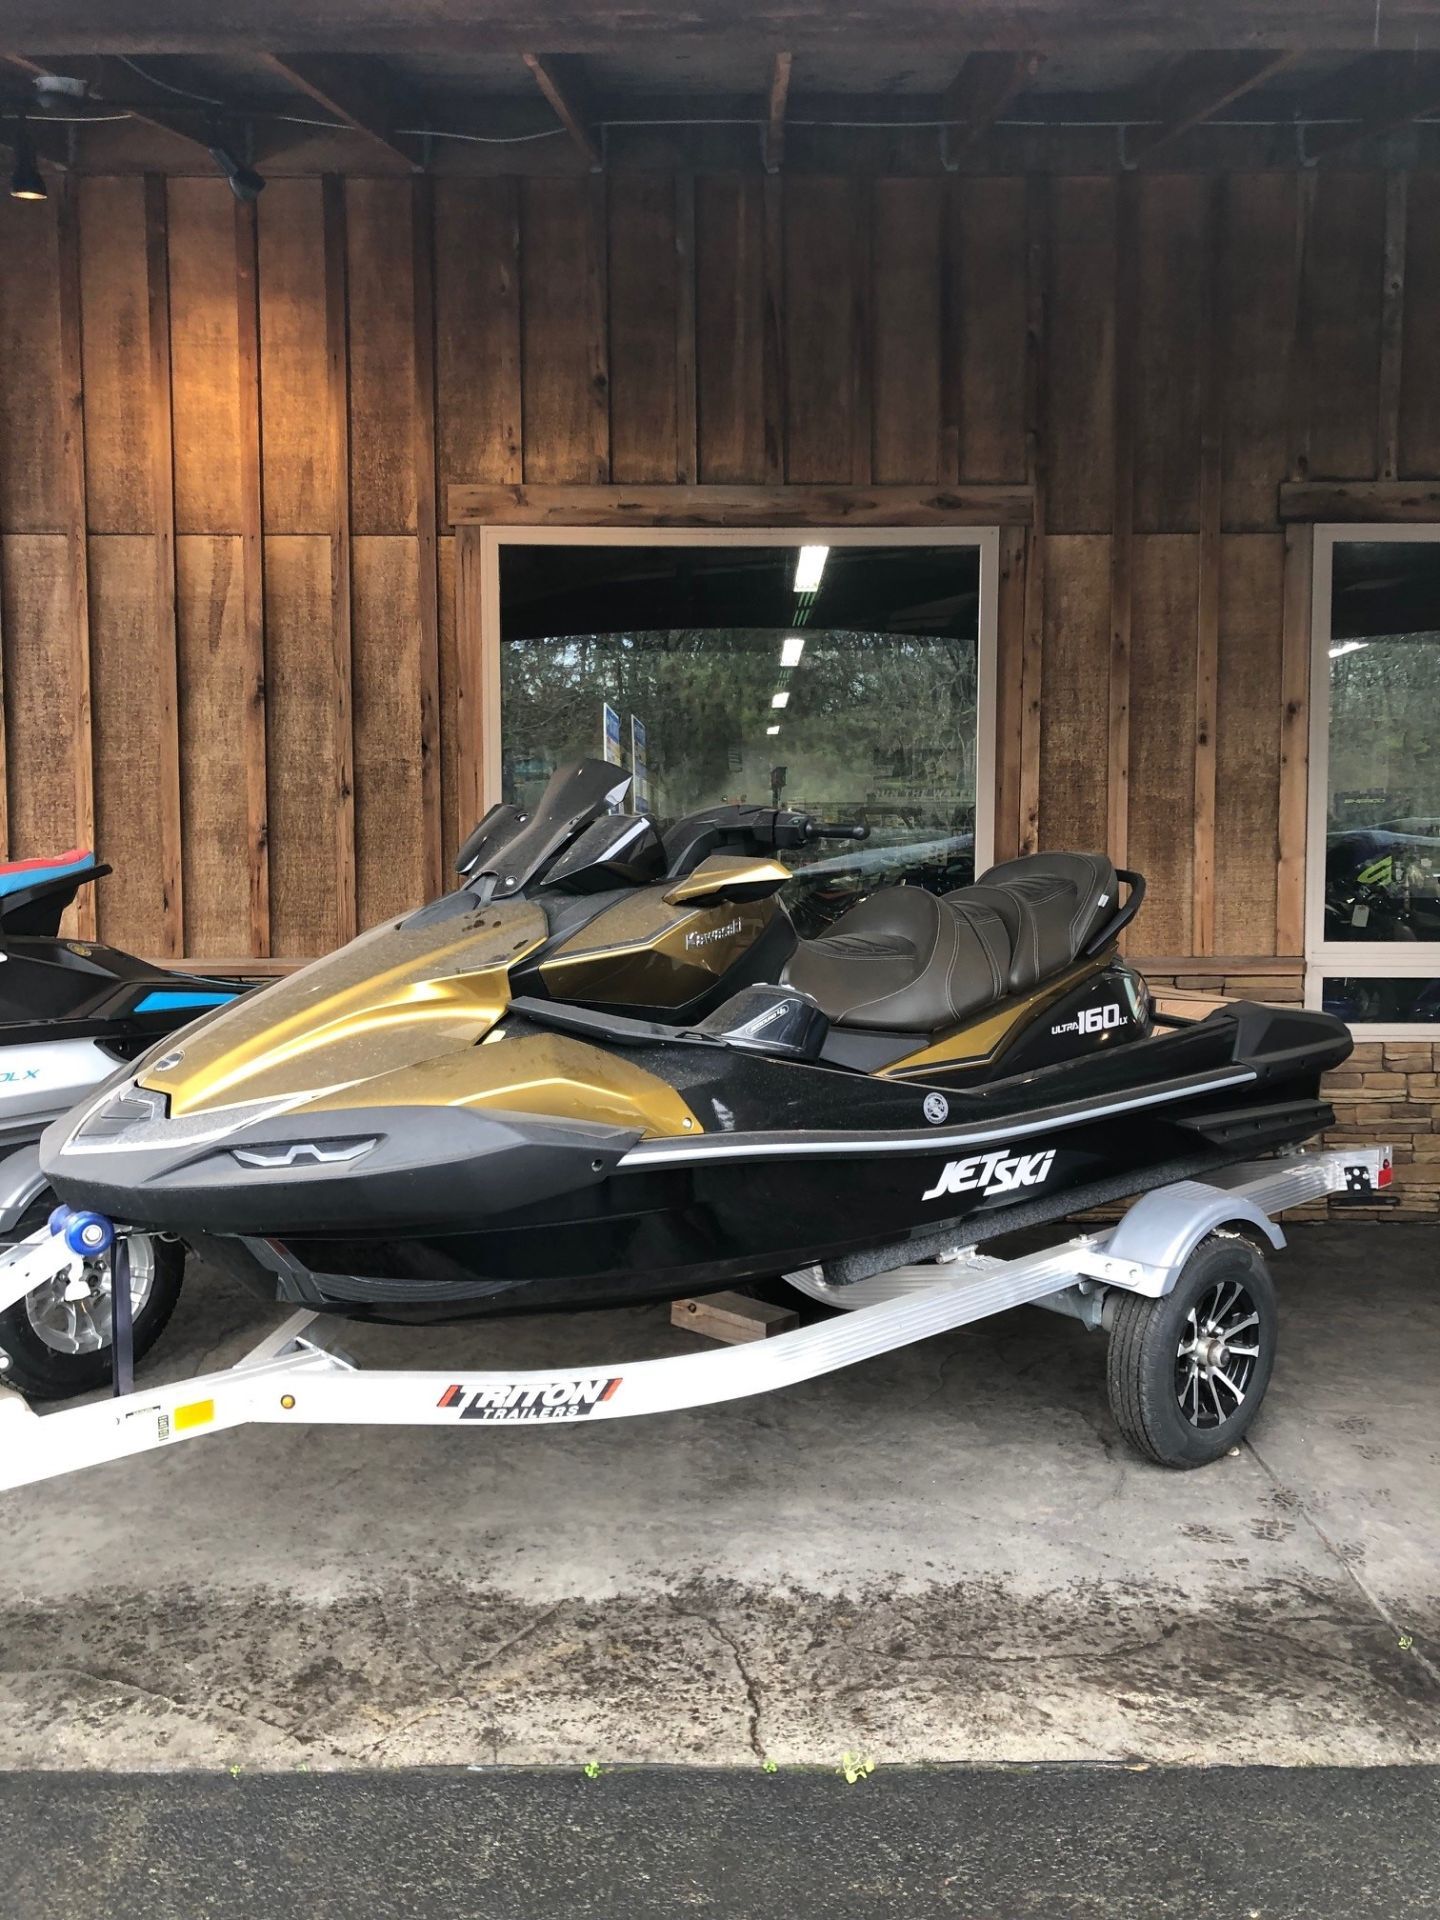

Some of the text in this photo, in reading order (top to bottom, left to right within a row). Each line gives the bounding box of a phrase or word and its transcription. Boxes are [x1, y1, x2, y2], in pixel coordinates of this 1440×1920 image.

[1051, 1003, 1128, 1035] ULTRA 160 LX
[457, 1378, 608, 1409] TRITON
[482, 1404, 579, 1420] TRAILERS
